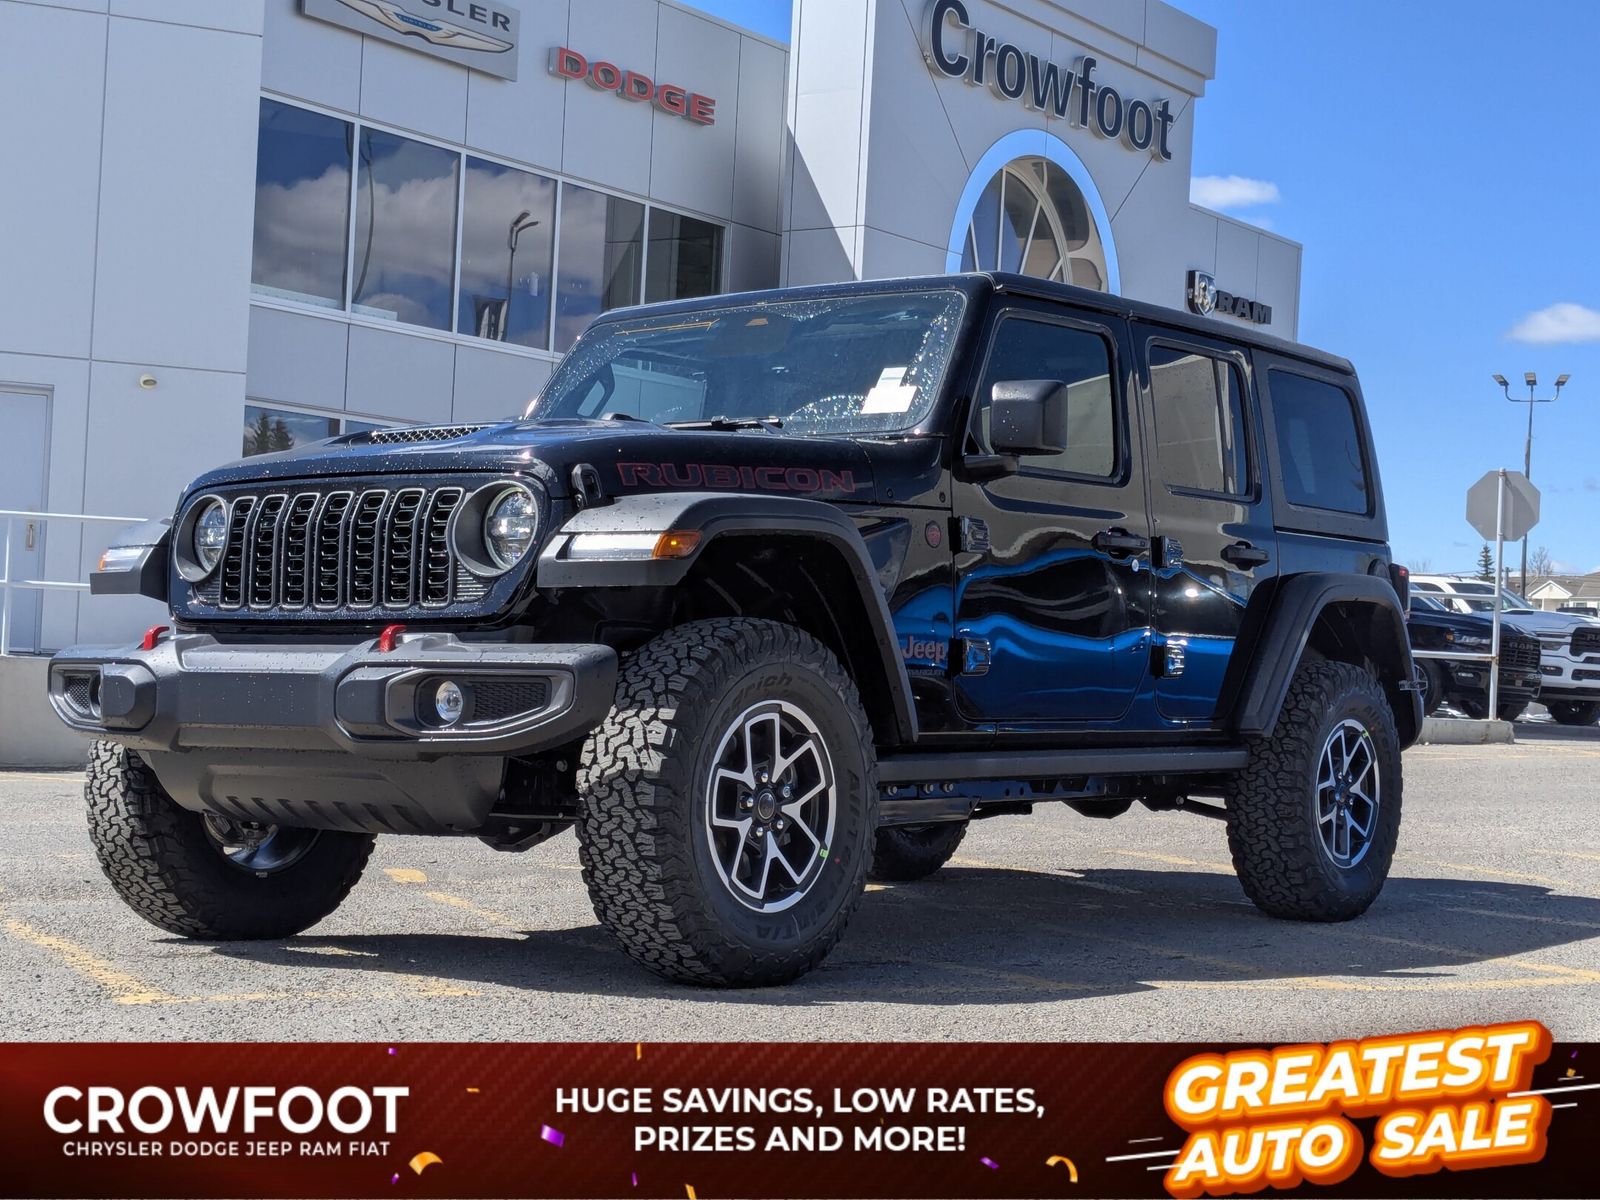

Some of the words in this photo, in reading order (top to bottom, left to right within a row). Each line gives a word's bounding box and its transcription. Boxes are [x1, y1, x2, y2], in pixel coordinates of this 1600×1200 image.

[550, 46, 717, 125] DODGE
[929, 0, 1174, 161] Crowfoot
[1215, 290, 1272, 325] RAM
[616, 463, 856, 493] RUBICON
[902, 635, 945, 663] Jeep
